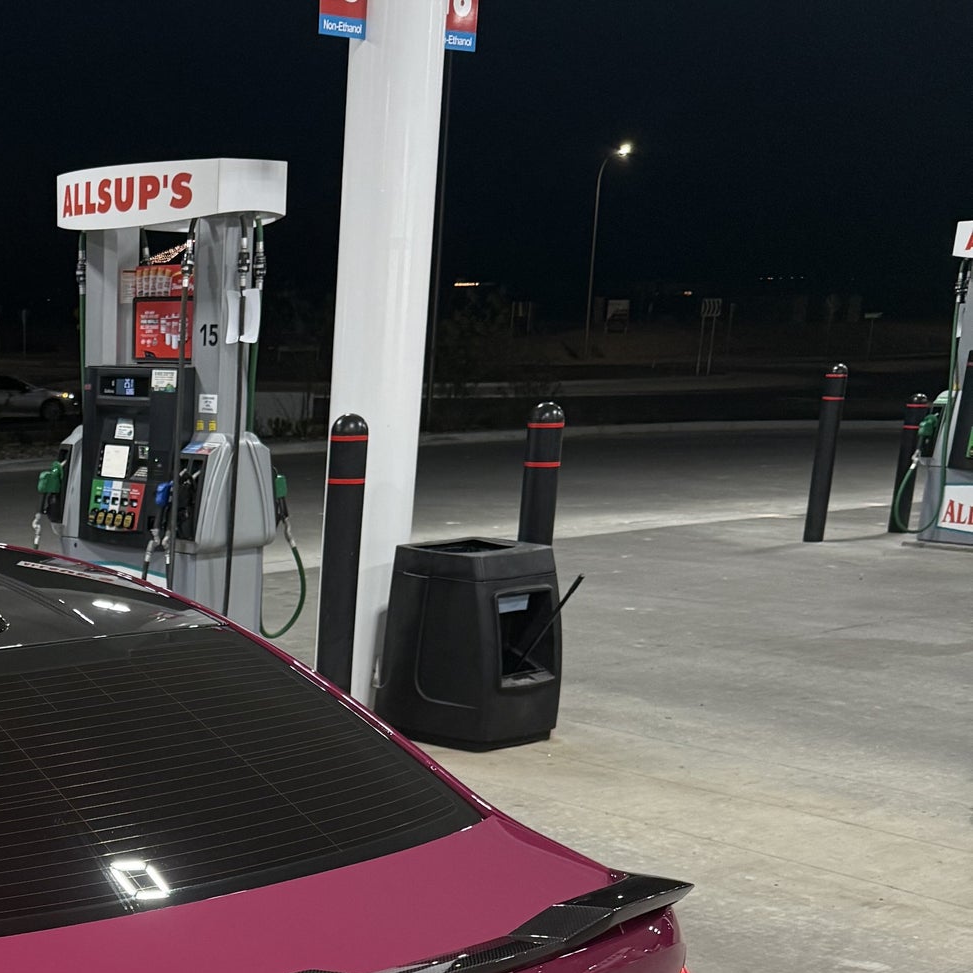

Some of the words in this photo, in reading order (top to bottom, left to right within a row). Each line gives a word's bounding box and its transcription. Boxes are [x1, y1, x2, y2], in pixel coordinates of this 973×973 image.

[324, 19, 363, 34] Non-Ethanol
[63, 172, 193, 218] ALLSUP'S
[199, 324, 219, 346] 15
